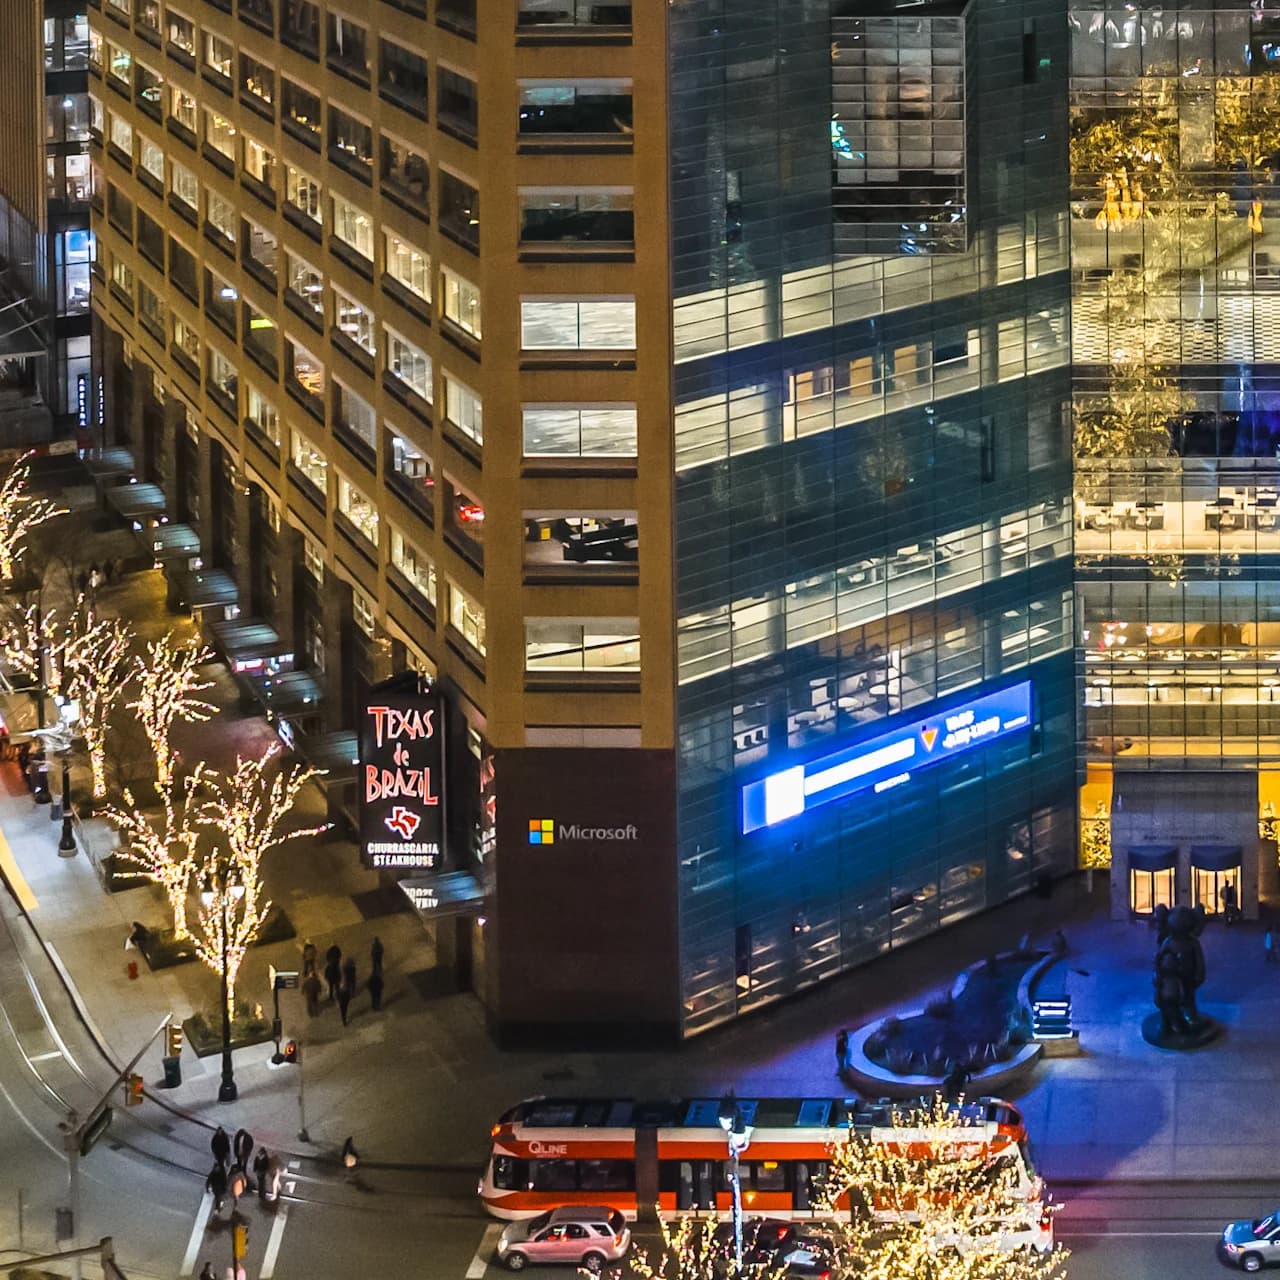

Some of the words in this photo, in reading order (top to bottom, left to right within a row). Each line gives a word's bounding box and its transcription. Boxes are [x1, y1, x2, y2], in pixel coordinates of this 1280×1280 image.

[367, 706, 434, 748] TEXAS
[393, 742, 410, 766] de
[559, 824, 638, 840] Microsoft
[367, 842, 439, 854] CHURRASCARIA
[373, 854, 434, 867] STEAKHOUSE
